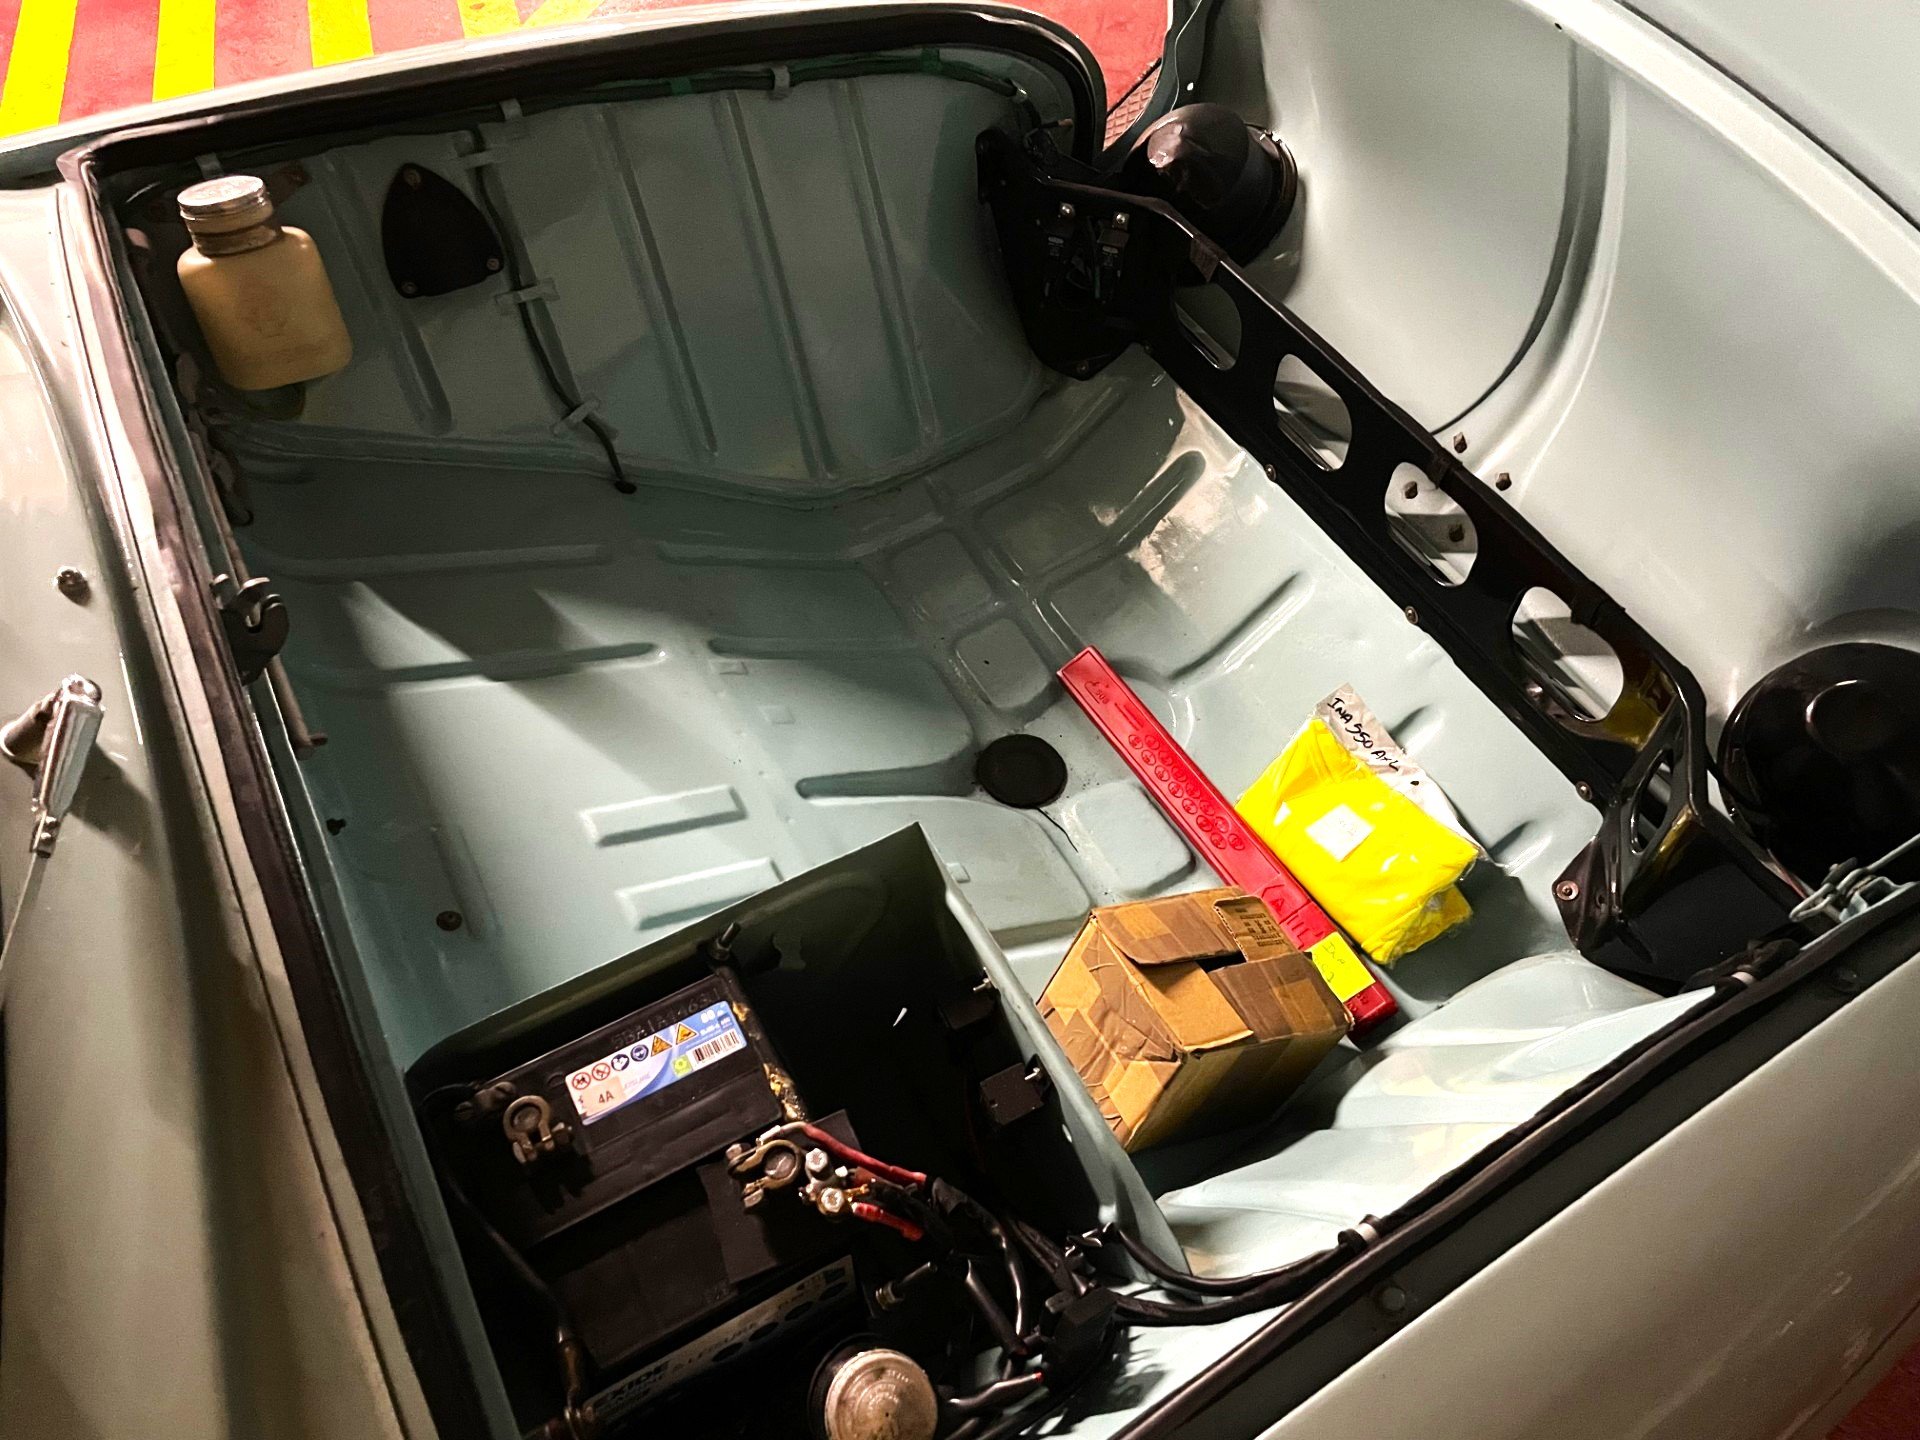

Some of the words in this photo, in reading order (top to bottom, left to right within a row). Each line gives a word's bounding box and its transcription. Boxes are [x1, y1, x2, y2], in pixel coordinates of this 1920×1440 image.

[1327, 697, 1353, 724] INA
[1345, 723, 1374, 749] 550
[598, 1089, 615, 1105] 4A
